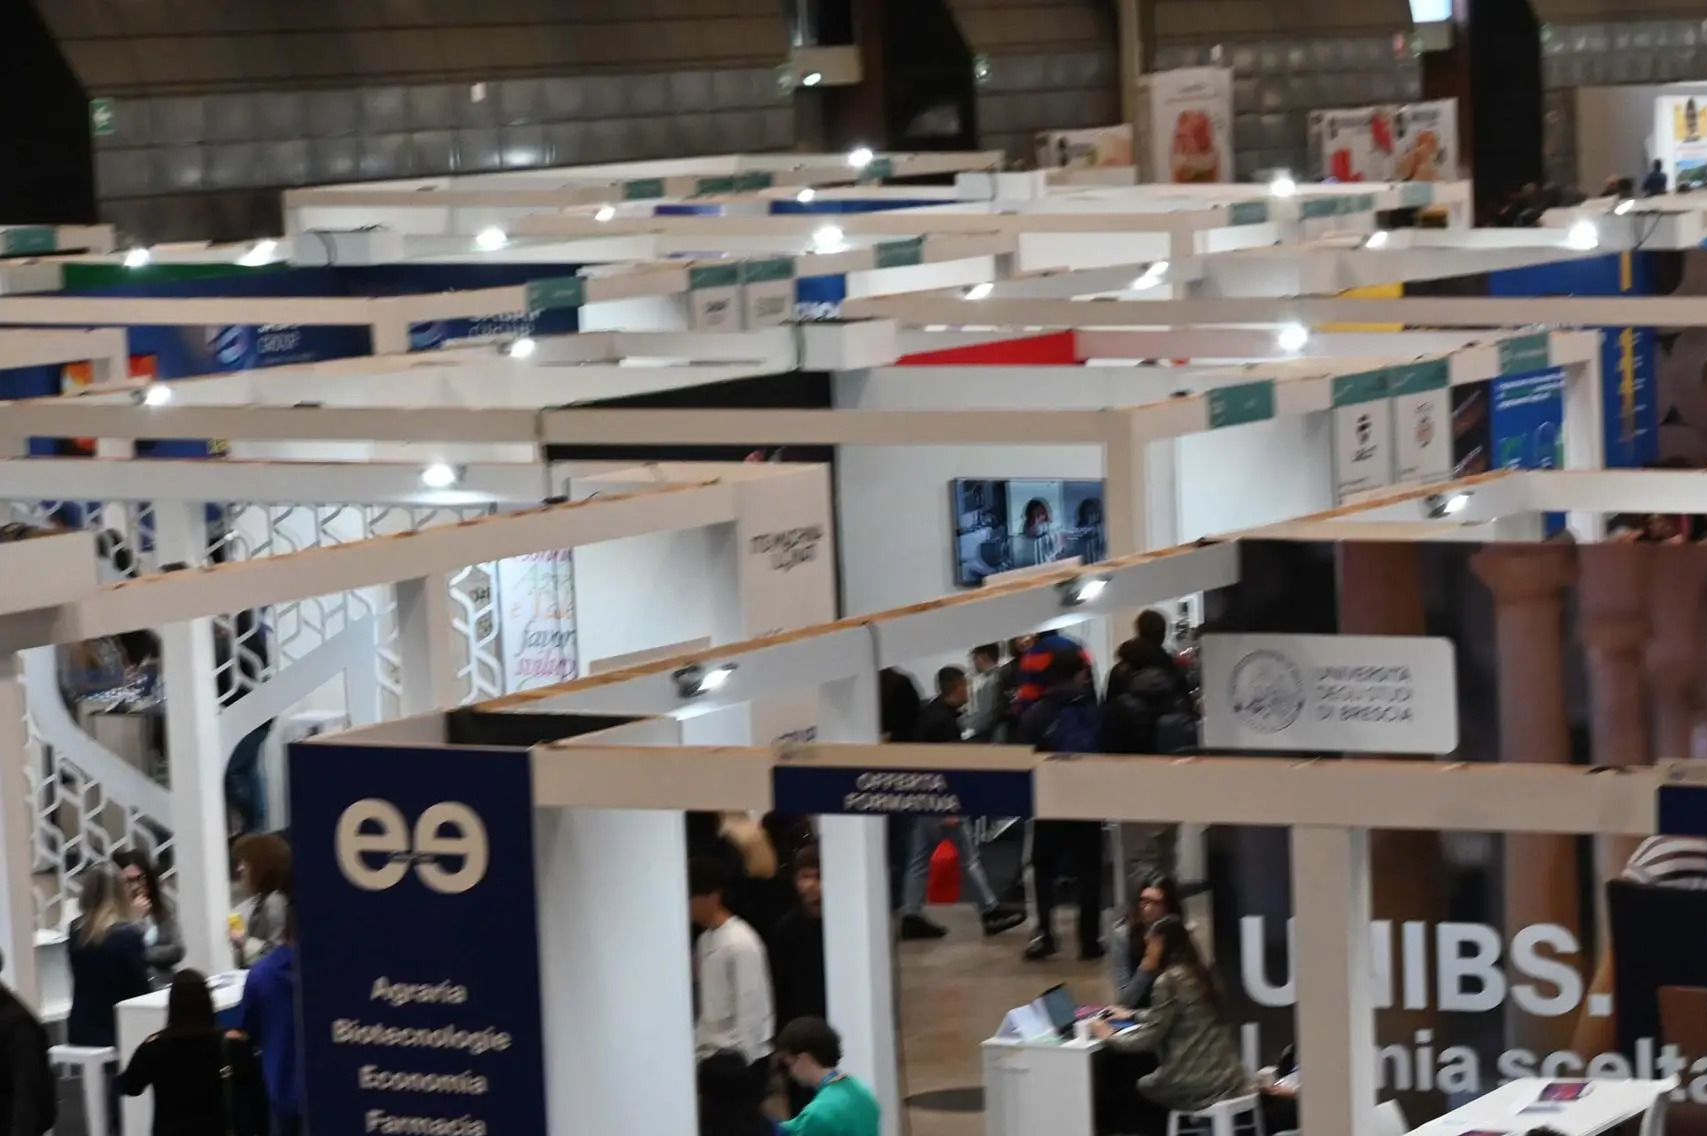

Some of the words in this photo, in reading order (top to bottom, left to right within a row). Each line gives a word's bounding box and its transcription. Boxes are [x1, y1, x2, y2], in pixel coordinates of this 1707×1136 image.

[370, 976, 468, 1006] Agraria
[331, 1018, 512, 1055] Biotecnologie
[357, 1064, 489, 1095] Economia
